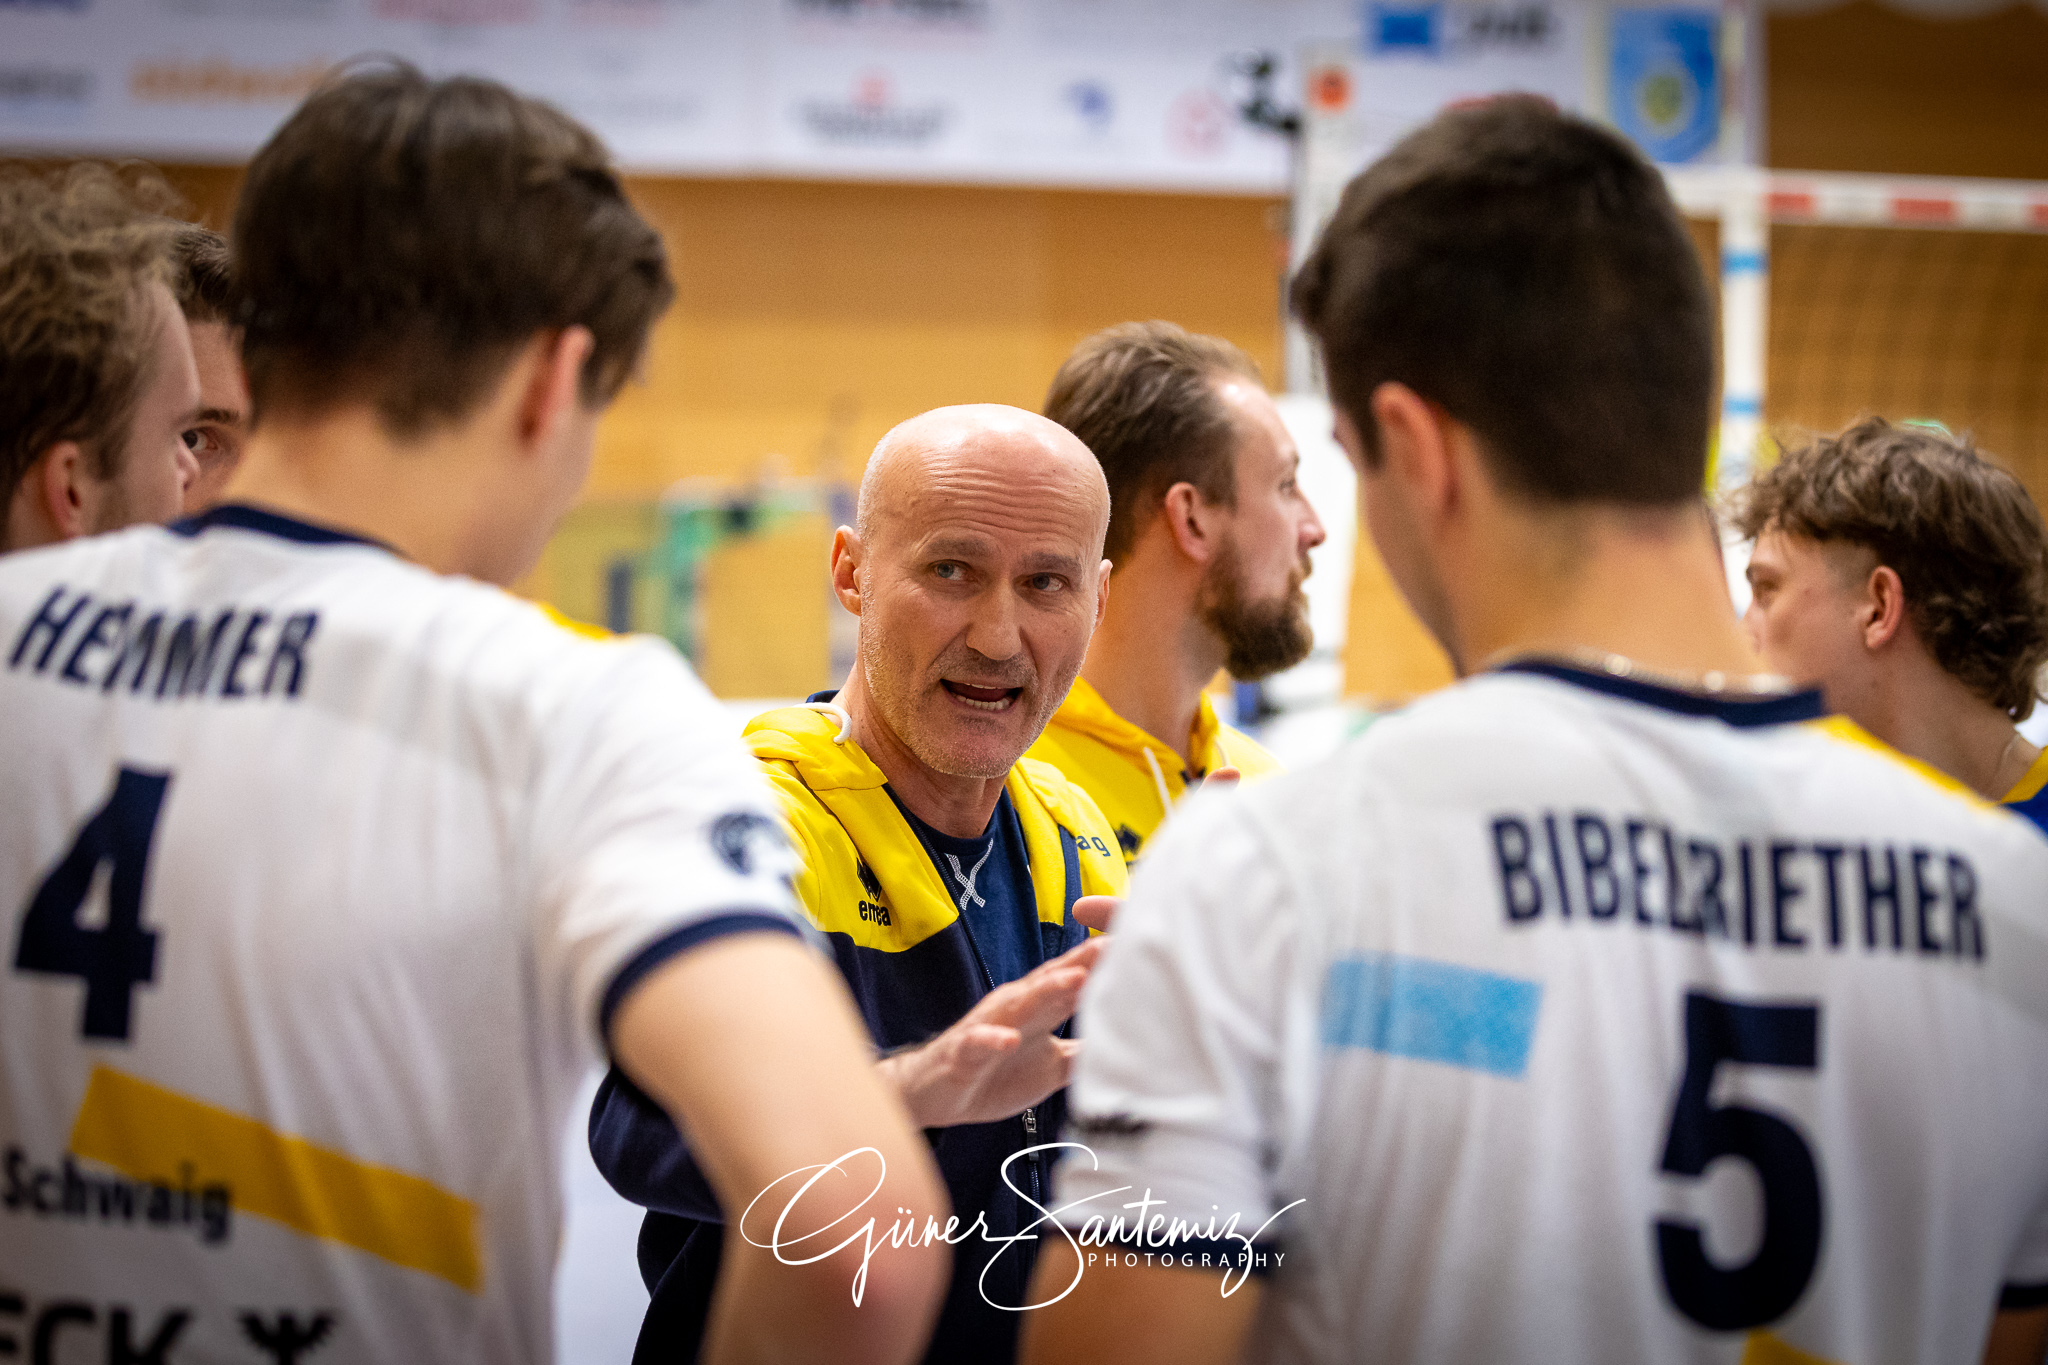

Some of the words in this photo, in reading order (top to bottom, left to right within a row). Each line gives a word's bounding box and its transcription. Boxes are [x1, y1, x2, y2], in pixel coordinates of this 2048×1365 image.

[13, 765, 174, 1041] 4
[2, 1144, 231, 1244] Schwaig
[1653, 989, 1825, 1331] 5
